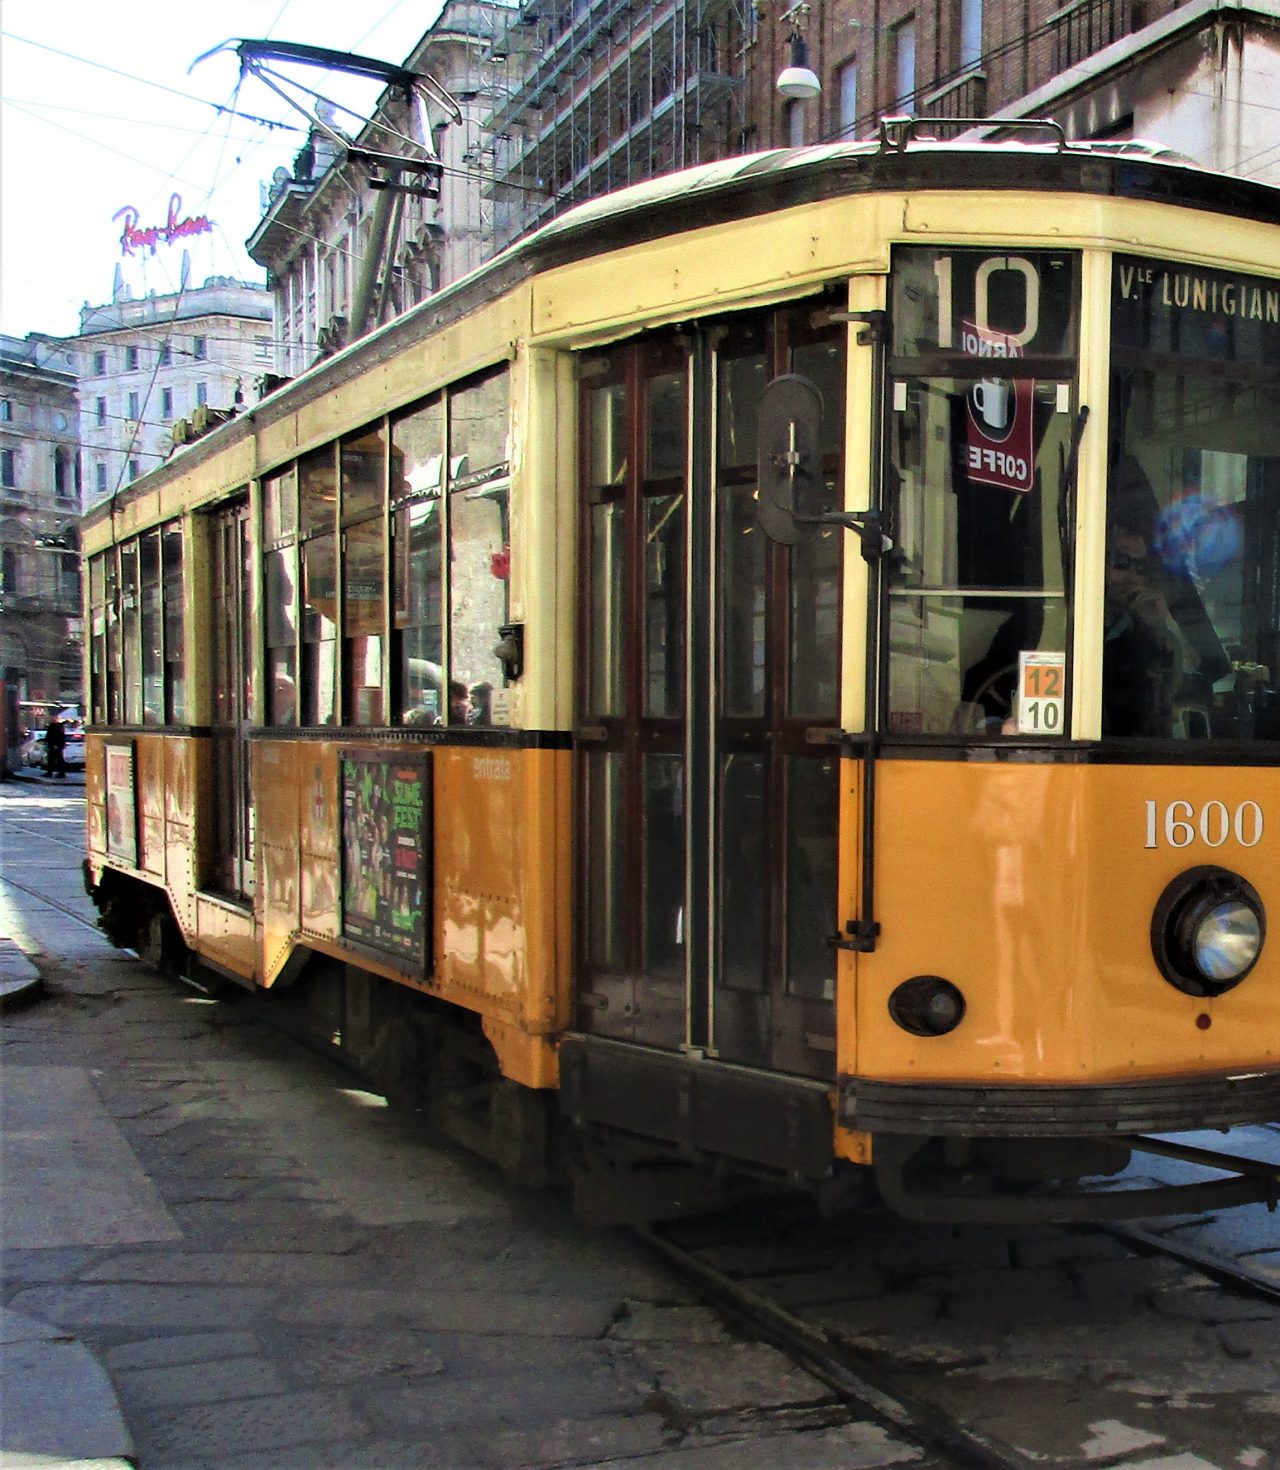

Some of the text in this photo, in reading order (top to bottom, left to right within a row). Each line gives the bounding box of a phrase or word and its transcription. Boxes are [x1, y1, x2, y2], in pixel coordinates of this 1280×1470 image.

[934, 257, 1039, 347] 10
[1029, 669, 1059, 695] 12
[1028, 702, 1058, 729] 10
[1143, 800, 1264, 849] 1600
